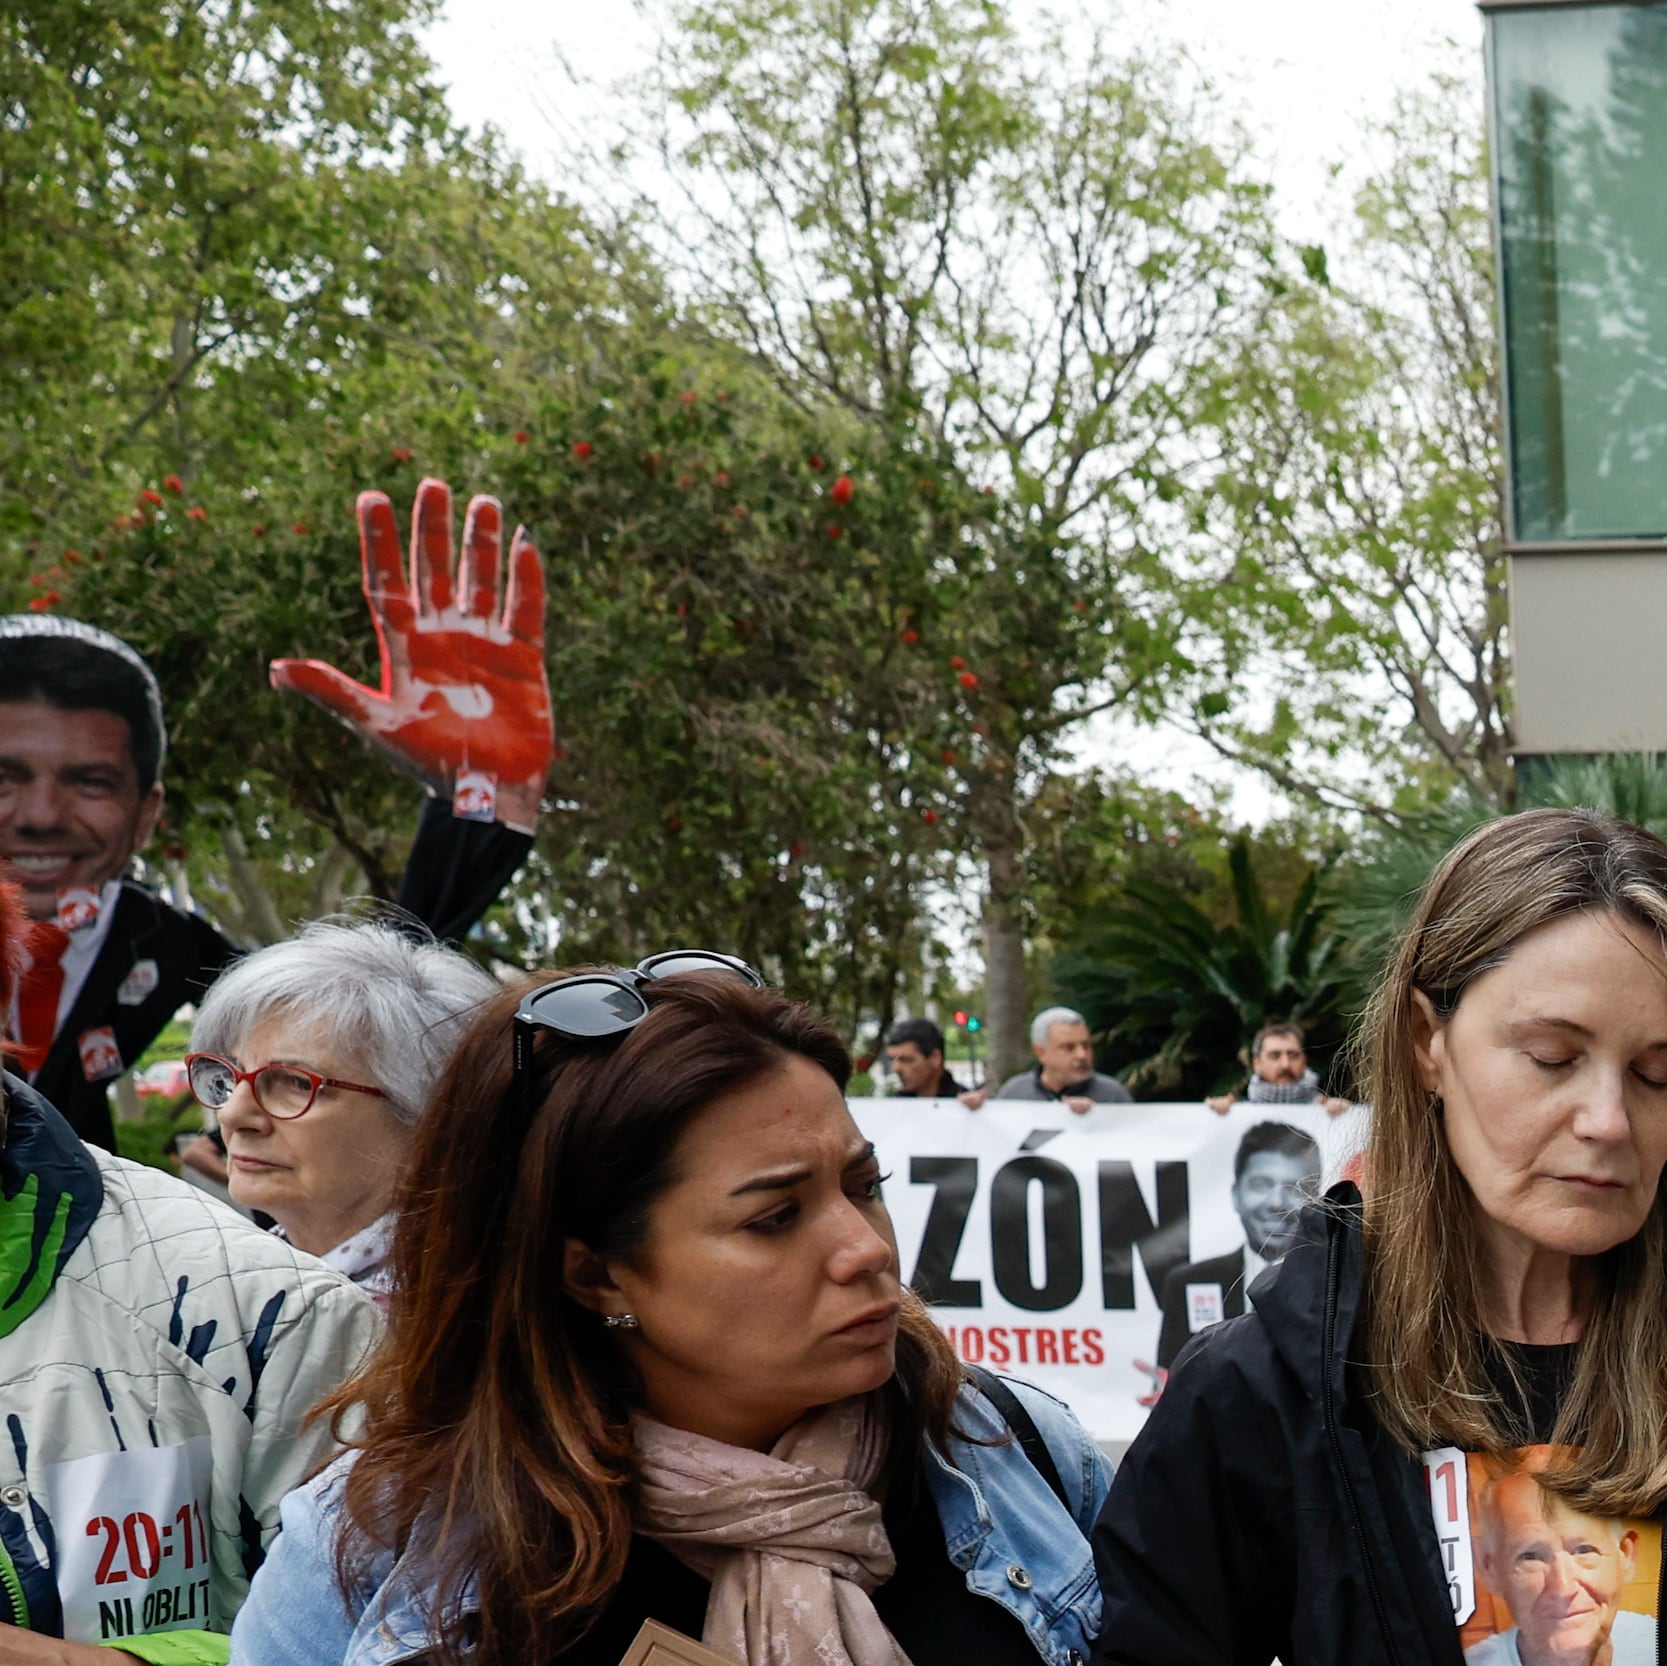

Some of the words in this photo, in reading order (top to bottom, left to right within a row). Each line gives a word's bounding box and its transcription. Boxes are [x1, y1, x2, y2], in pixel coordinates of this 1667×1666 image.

[909, 1129, 1191, 1312] ZÓN
[86, 1498, 209, 1586] 20:11
[98, 1597, 135, 1639] NI
[142, 1578, 209, 1630] OBLIT
